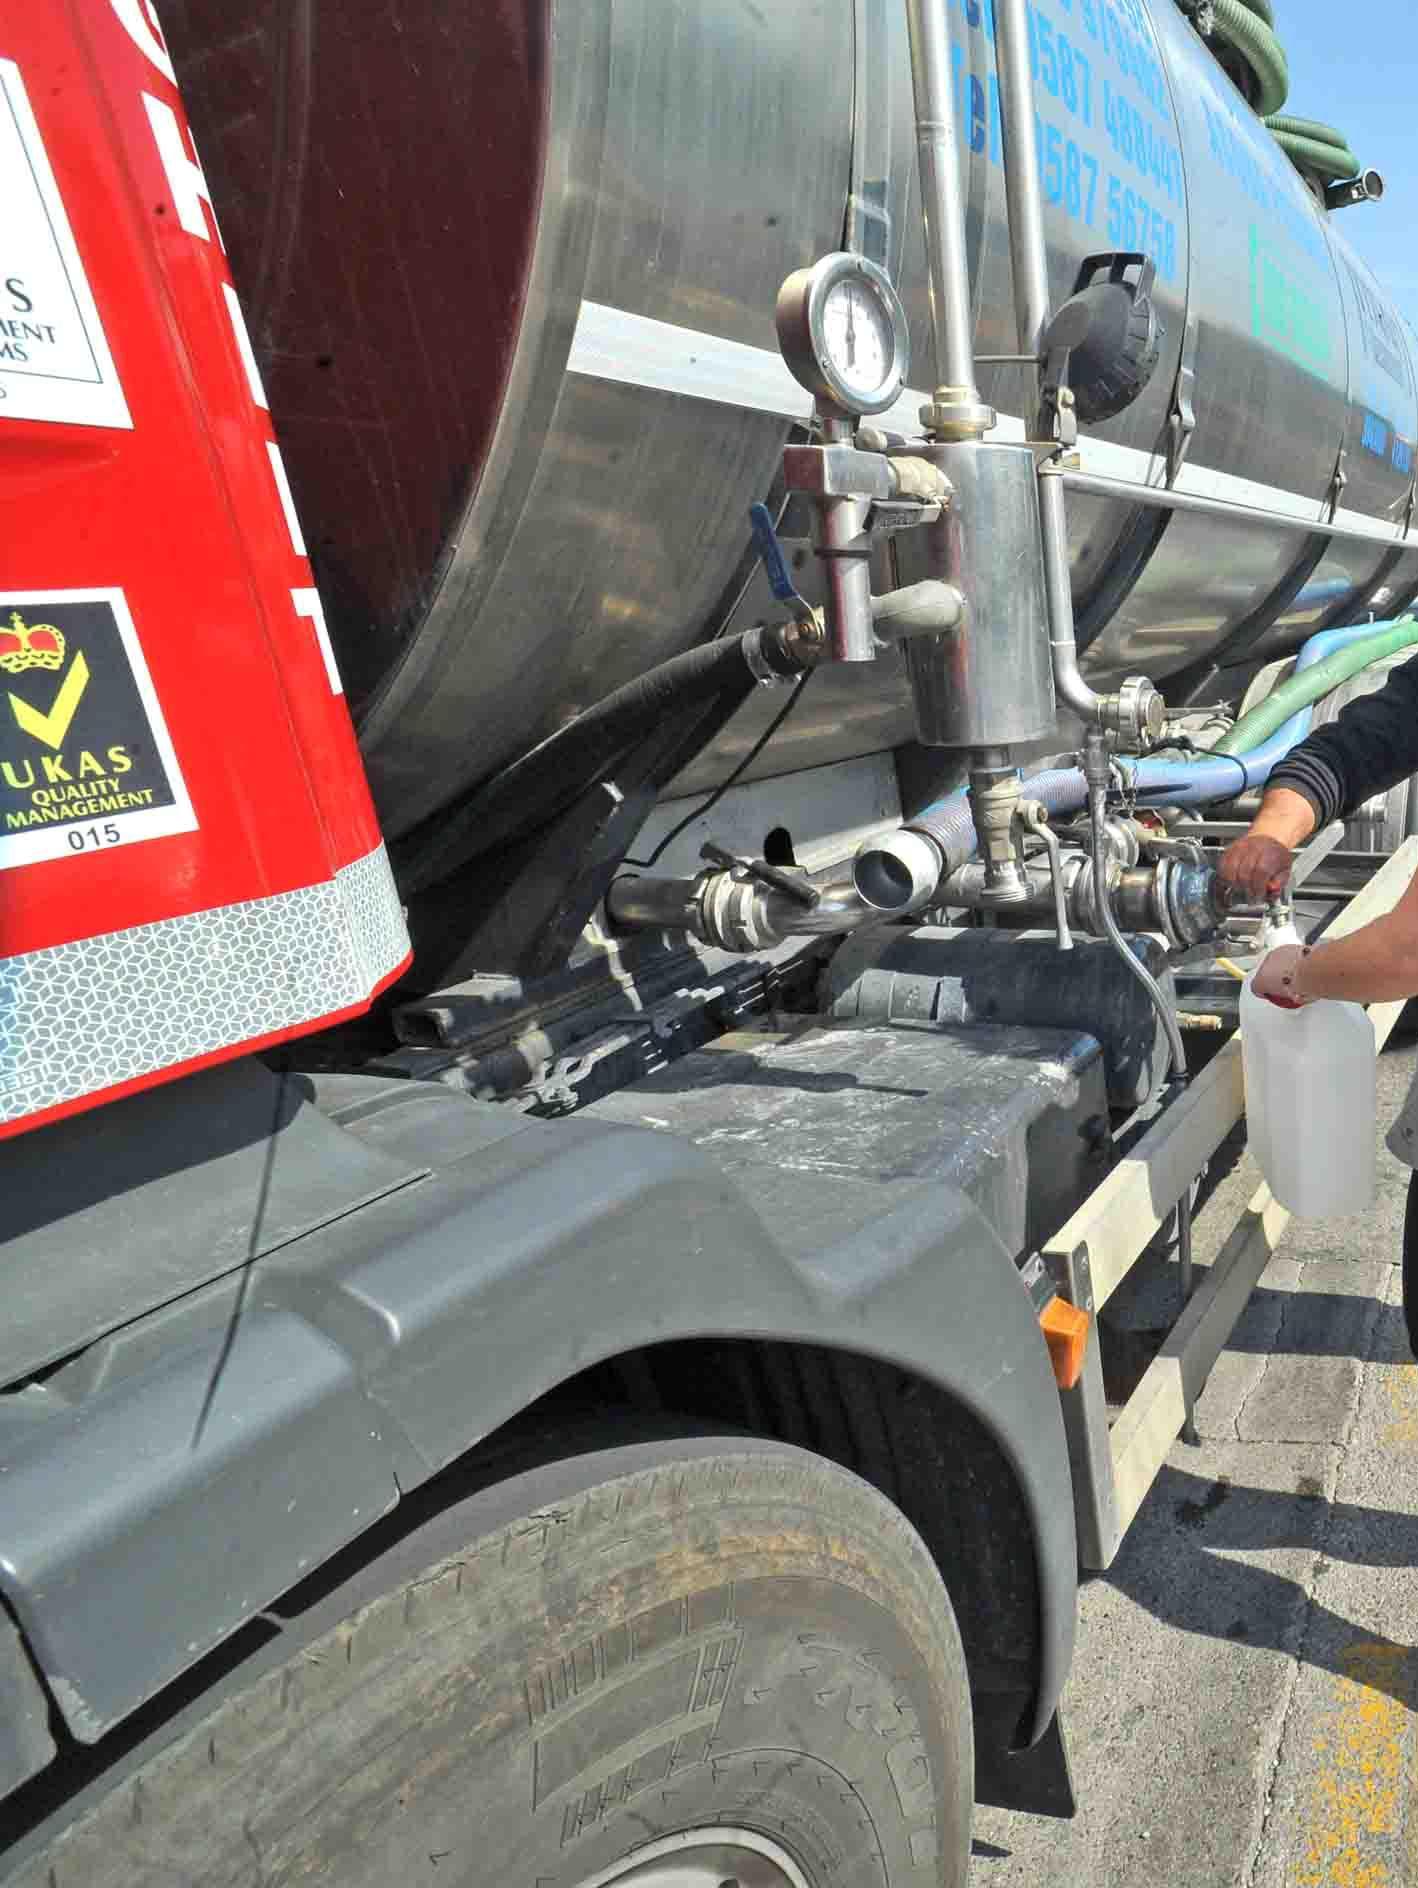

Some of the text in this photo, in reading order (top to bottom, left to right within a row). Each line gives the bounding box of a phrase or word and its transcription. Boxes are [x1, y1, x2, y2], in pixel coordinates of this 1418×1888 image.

[0, 745, 133, 789] UKAS
[5, 788, 153, 829] MANAGEMENT
[31, 777, 121, 808] QUALITY
[67, 823, 121, 851] 015
